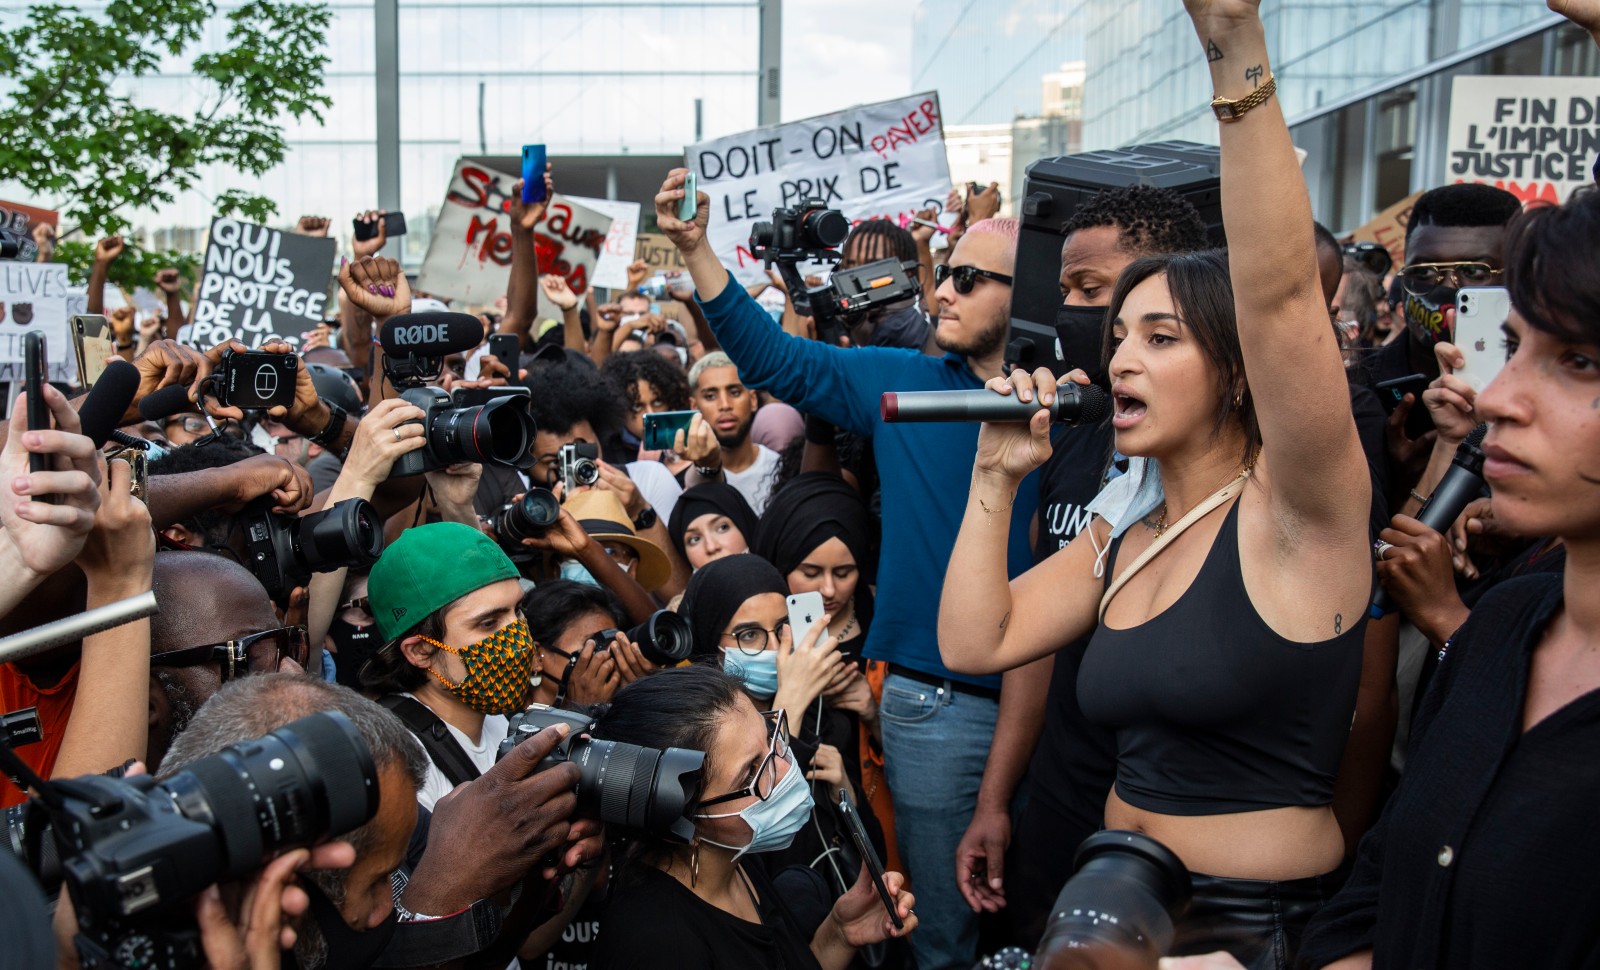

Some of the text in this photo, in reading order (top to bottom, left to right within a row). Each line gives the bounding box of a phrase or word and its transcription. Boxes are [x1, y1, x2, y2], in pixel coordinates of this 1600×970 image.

[871, 99, 939, 160] PAYER
[1495, 96, 1600, 125] FIN D
[1452, 151, 1586, 181] JUSTICE
[724, 162, 902, 221] LE PRIX DE
[212, 217, 281, 258] QUI
[206, 244, 295, 287] NOUS
[195, 299, 274, 334] DE LA
[201, 272, 328, 321] PROTEGE
[394, 324, 450, 345] RØDE
